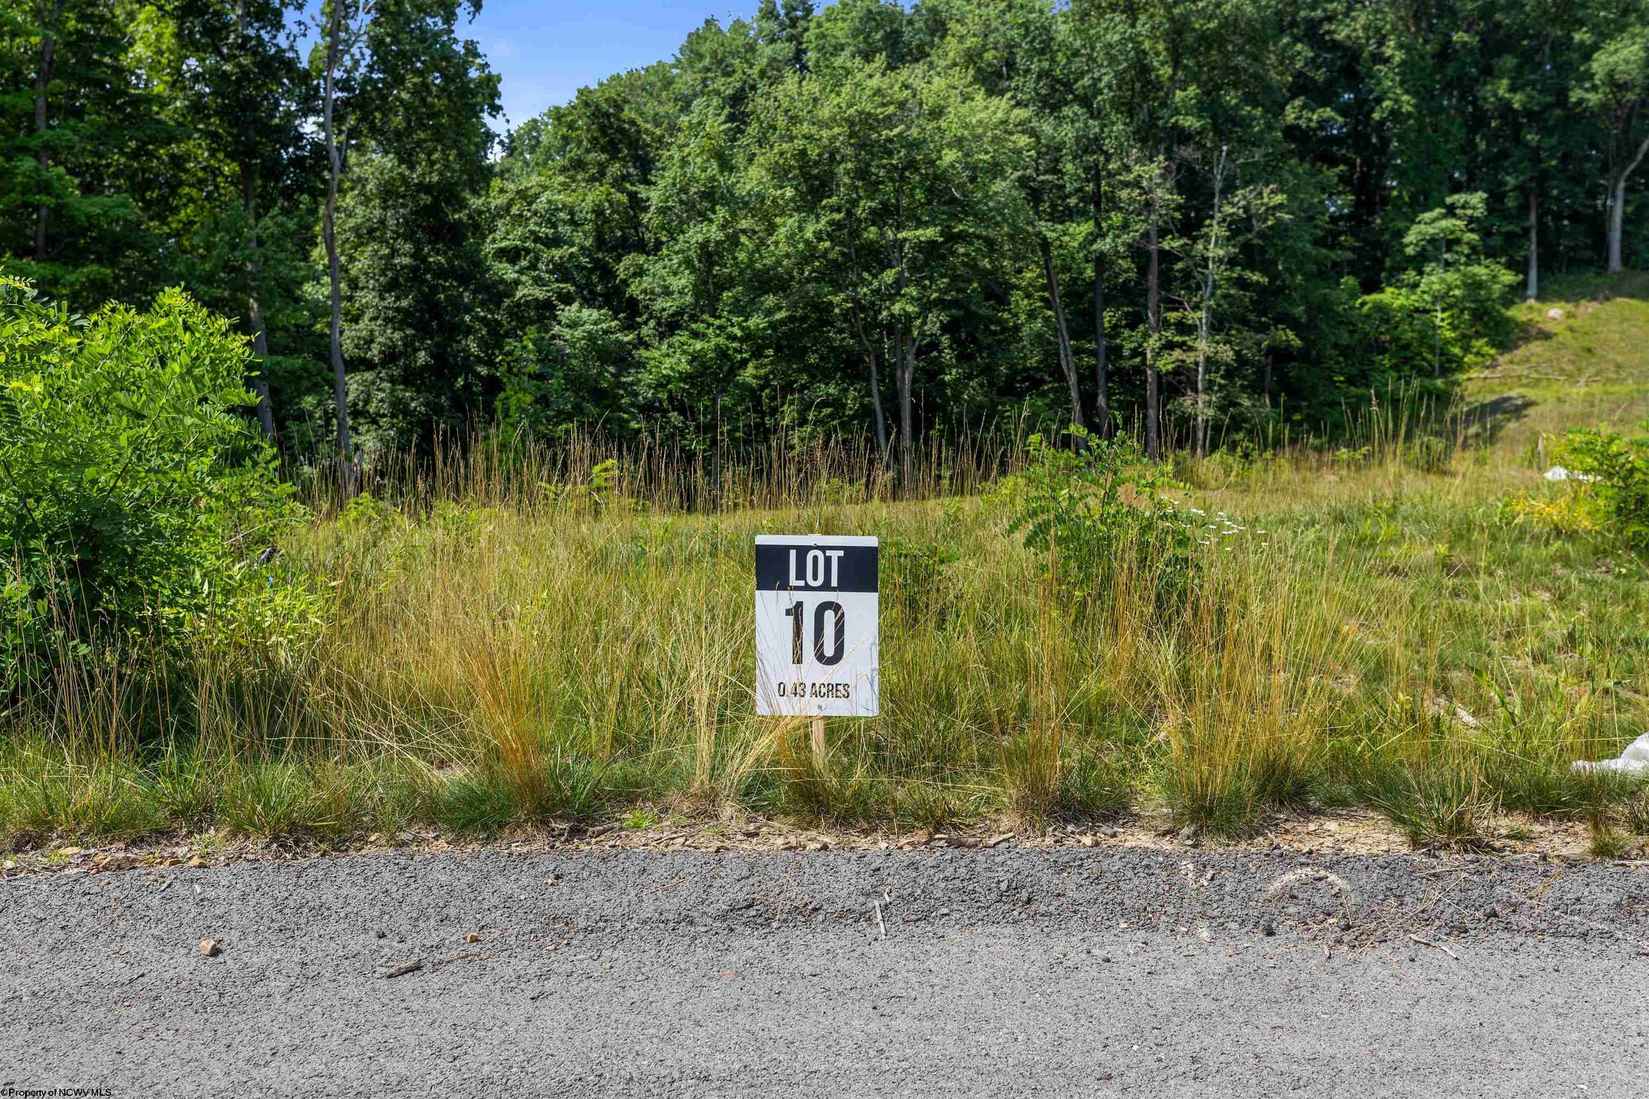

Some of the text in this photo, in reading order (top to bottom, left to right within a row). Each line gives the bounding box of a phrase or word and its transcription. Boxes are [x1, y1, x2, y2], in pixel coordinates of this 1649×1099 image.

[789, 549, 844, 587] LOT
[785, 600, 845, 666] 10
[810, 682, 850, 699] ACRES
